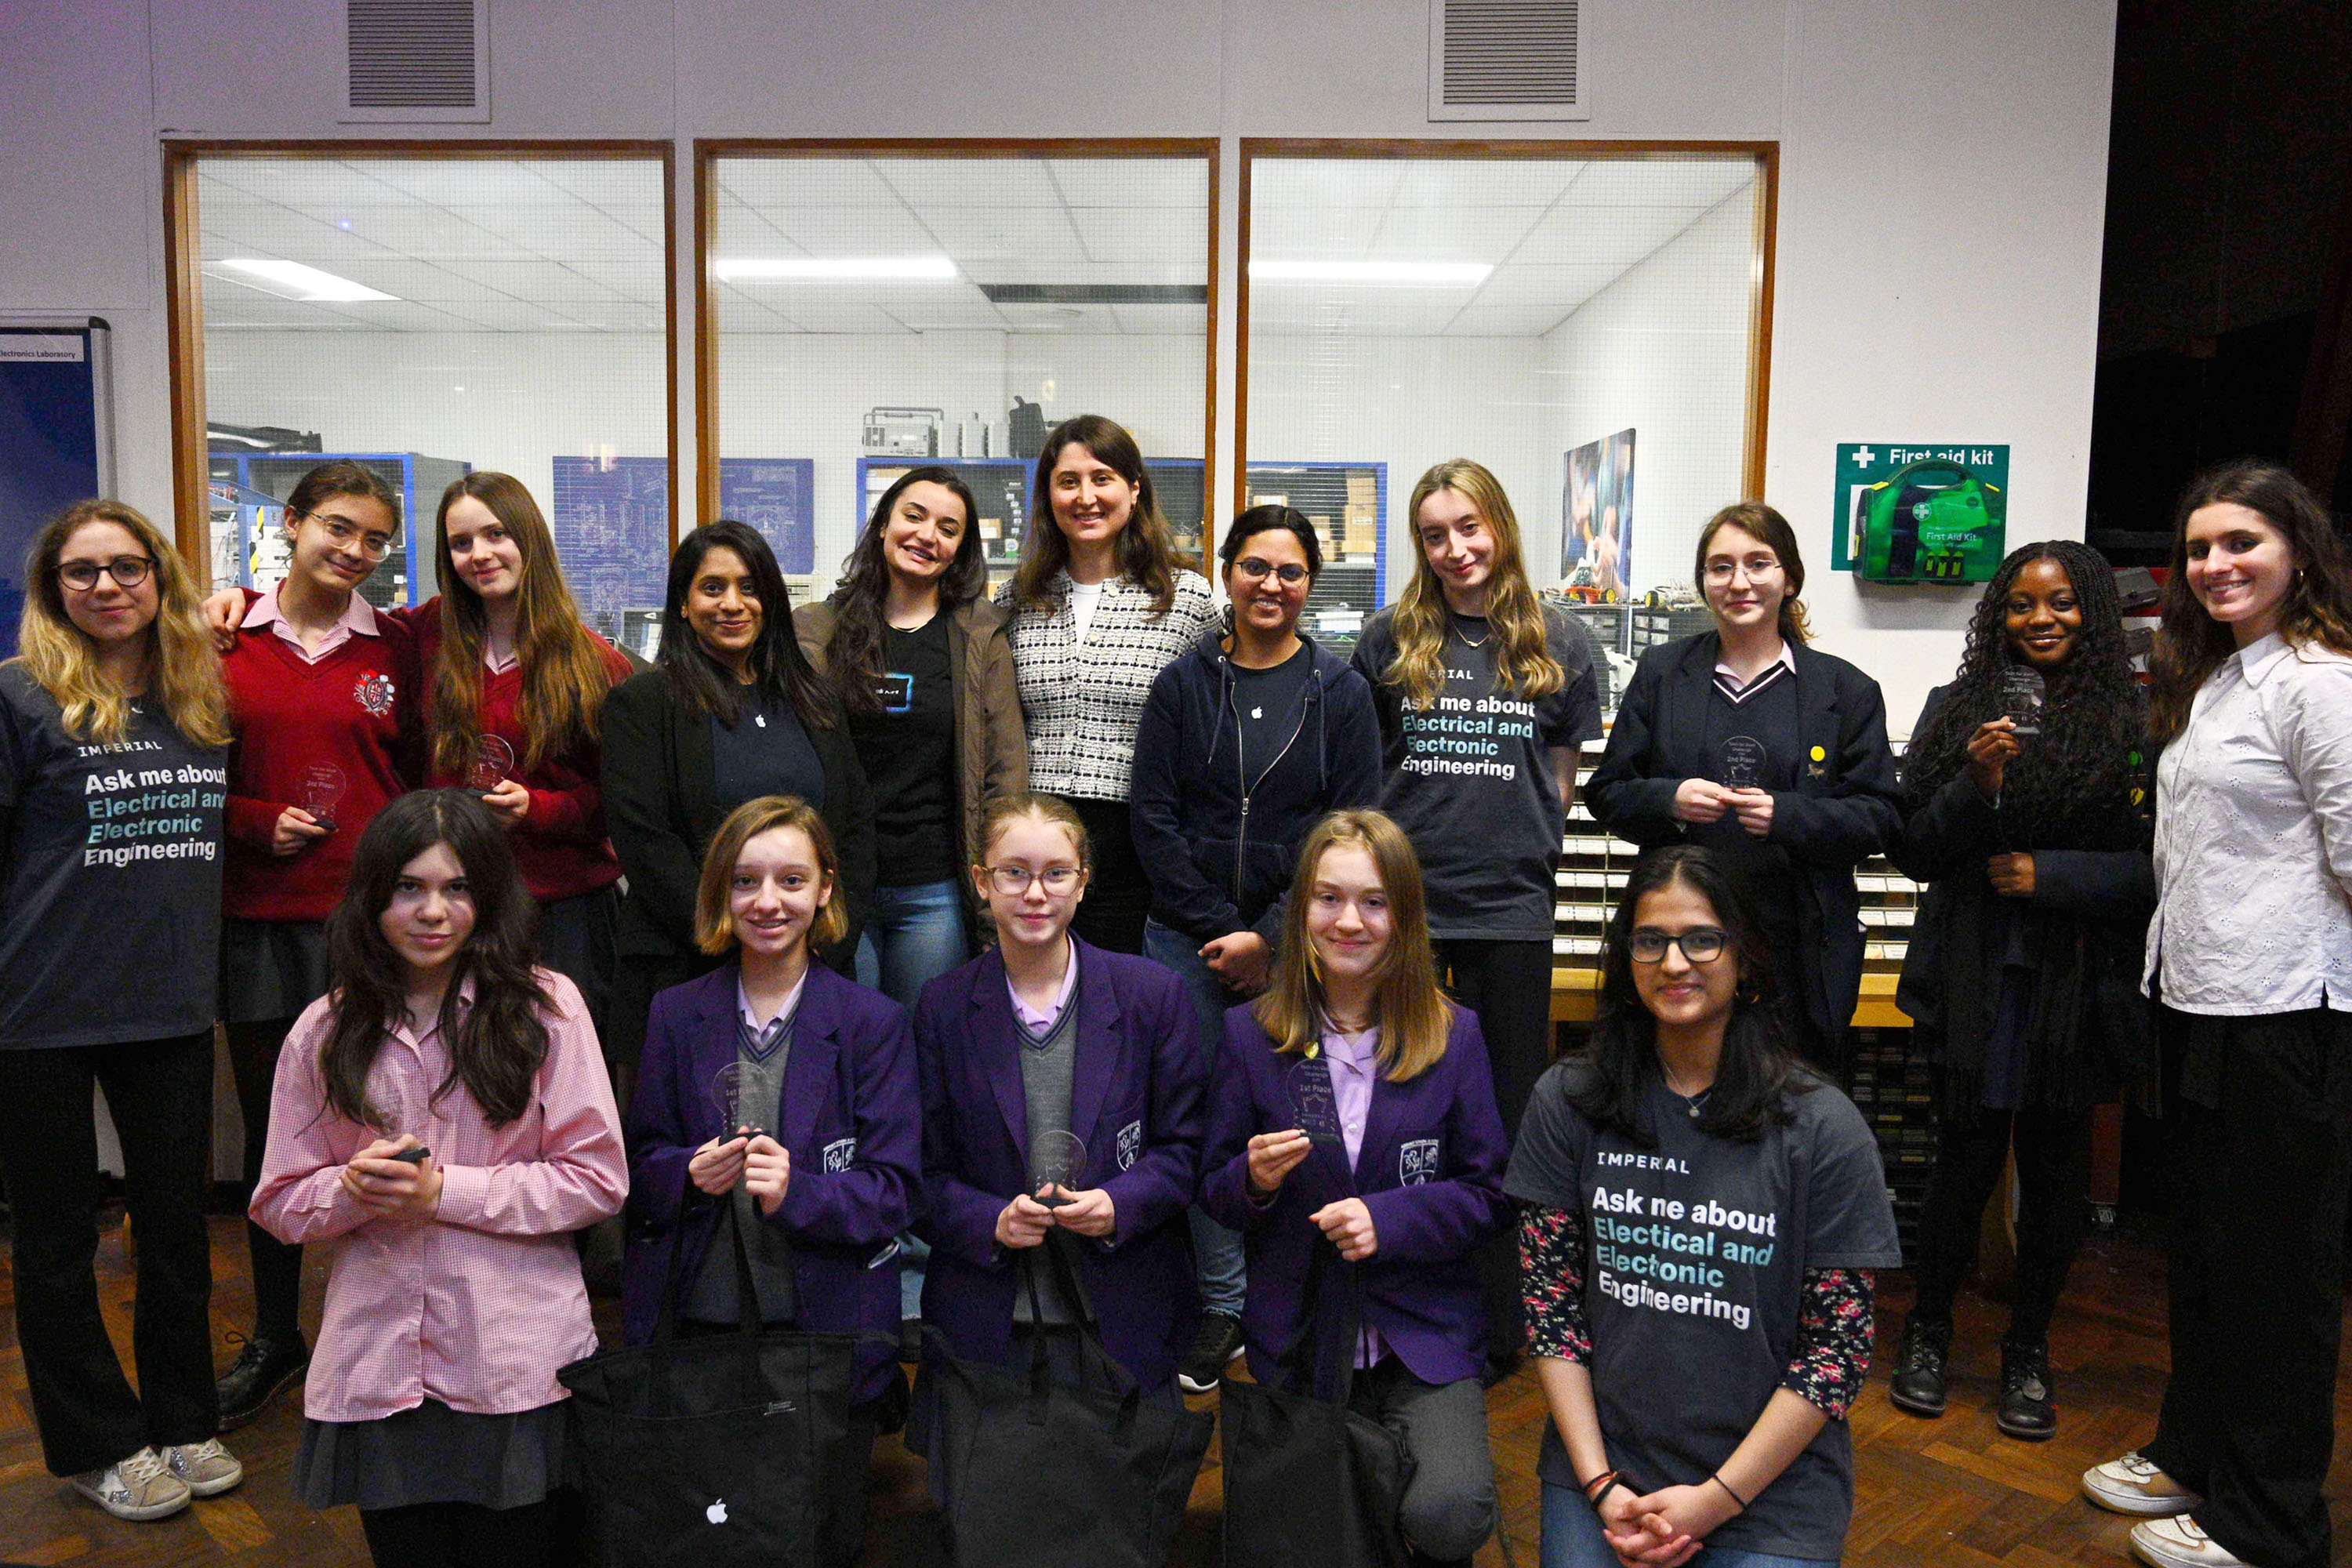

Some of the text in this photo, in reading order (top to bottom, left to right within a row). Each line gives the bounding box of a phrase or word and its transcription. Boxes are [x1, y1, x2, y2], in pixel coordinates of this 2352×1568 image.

[37, 350, 75, 359] Laboratory
[1889, 448, 1994, 465] First aid kit
[1439, 697, 1472, 712] me
[1475, 695, 1536, 717] about
[1403, 714, 1534, 739] Electrical and
[78, 741, 163, 757] IMPERIAL
[85, 764, 227, 795] Ask me about
[1401, 755, 1515, 781] Engineering
[87, 788, 197, 819] Electrical
[88, 814, 202, 844] Electronic
[84, 837, 216, 868] Engineering
[1592, 1186, 1644, 1214] Ask
[1691, 1200, 1776, 1237] about
[1594, 1216, 1773, 1266] Electical and
[1596, 1244, 1724, 1287] Electonic
[1599, 1270, 1751, 1330] Engineering
